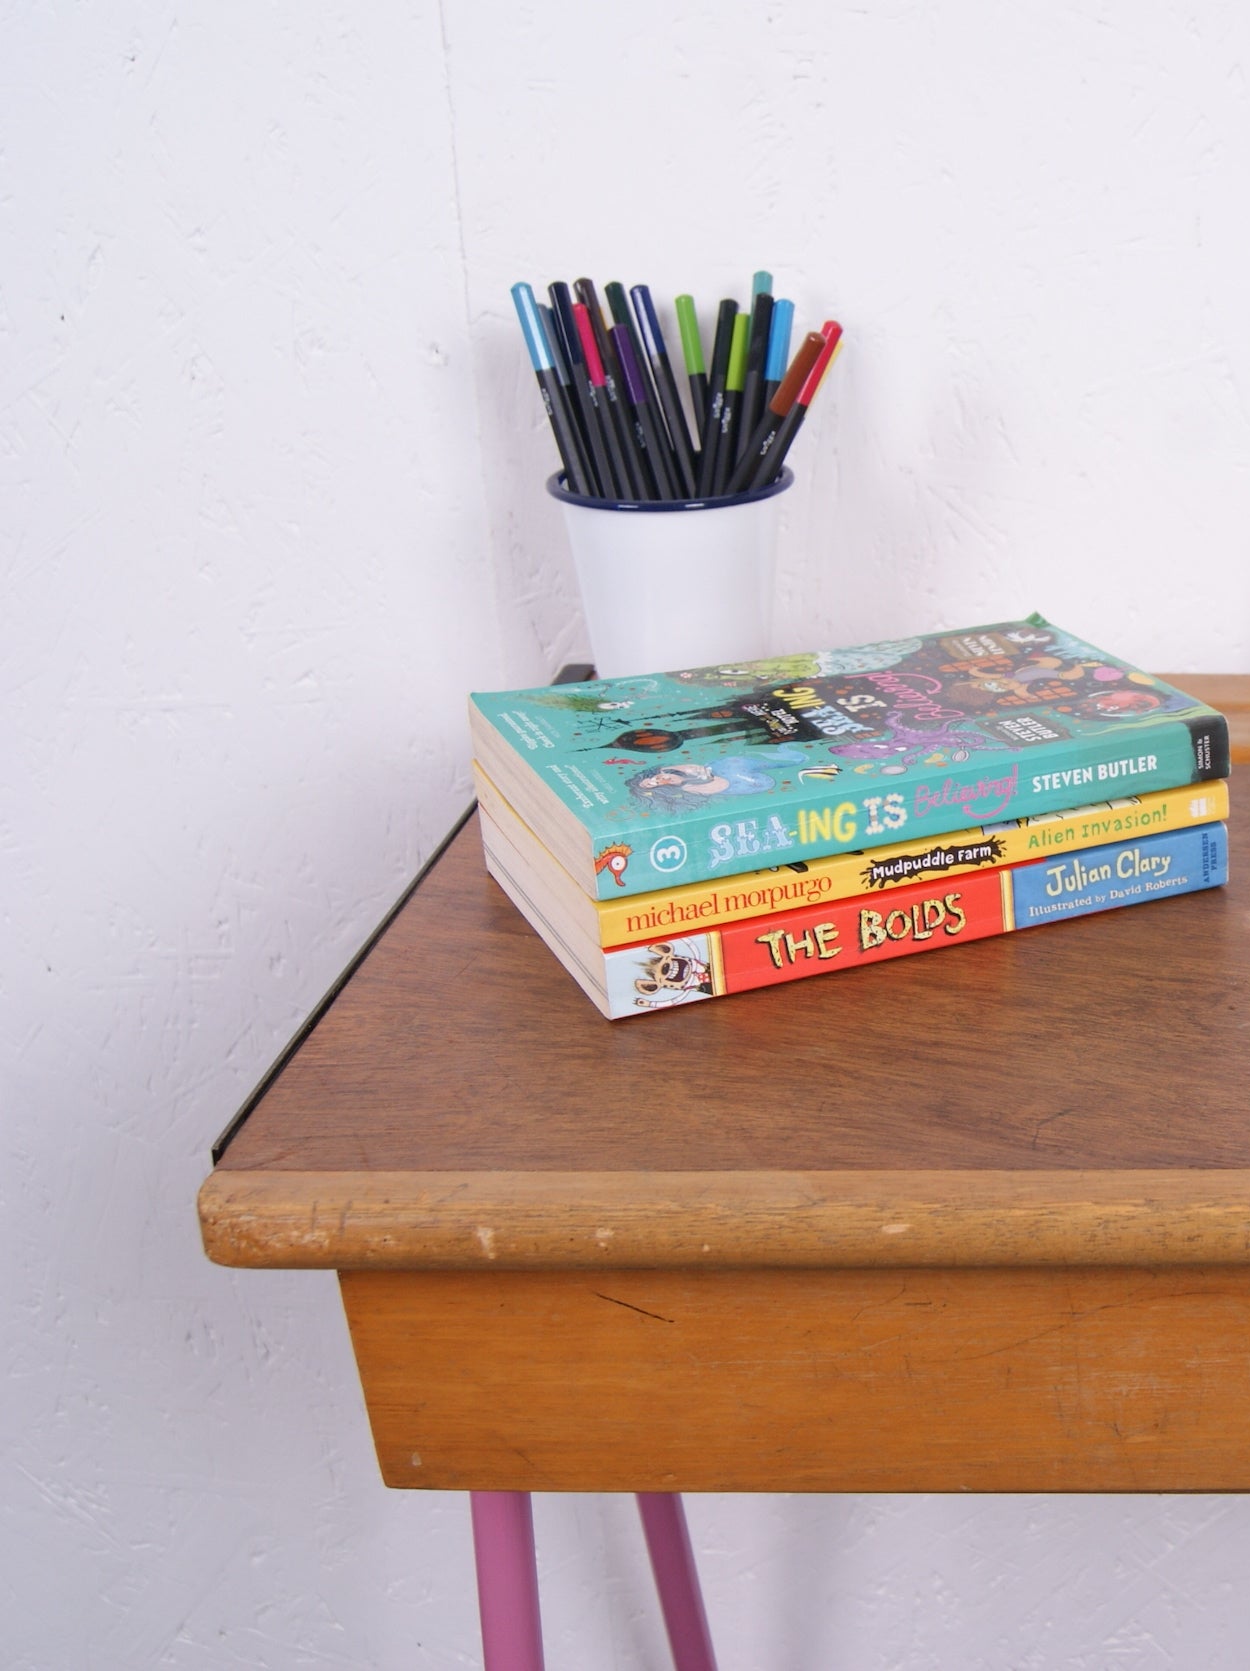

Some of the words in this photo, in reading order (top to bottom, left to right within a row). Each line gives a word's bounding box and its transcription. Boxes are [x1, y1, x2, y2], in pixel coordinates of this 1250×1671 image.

[773, 687, 874, 736] SEA-ING
[836, 694, 887, 713] IS
[998, 720, 1042, 742] STEVEN
[1016, 717, 1059, 739] BUTLER
[708, 801, 857, 870] SEA-ING
[862, 793, 907, 835] IS
[914, 764, 1018, 818] Believing!
[1032, 766, 1093, 793] STEVEN
[1098, 755, 1158, 780] BUTLER
[1028, 825, 1075, 849] Alien
[1082, 804, 1167, 840] Invasion!
[873, 850, 954, 880] Mudpuddle
[958, 844, 992, 862] Farm
[1046, 860, 1111, 897] Julian
[1117, 848, 1171, 879] Clary
[1202, 832, 1210, 883] ANDERSEN
[626, 893, 719, 932] michael
[725, 876, 832, 914] morpurgo
[1028, 895, 1092, 917] Illustrated
[1095, 894, 1106, 904] by
[1110, 883, 1142, 900] David
[1145, 875, 1188, 892] Roberts
[757, 923, 842, 968] THE
[859, 893, 965, 950] BOLDS
